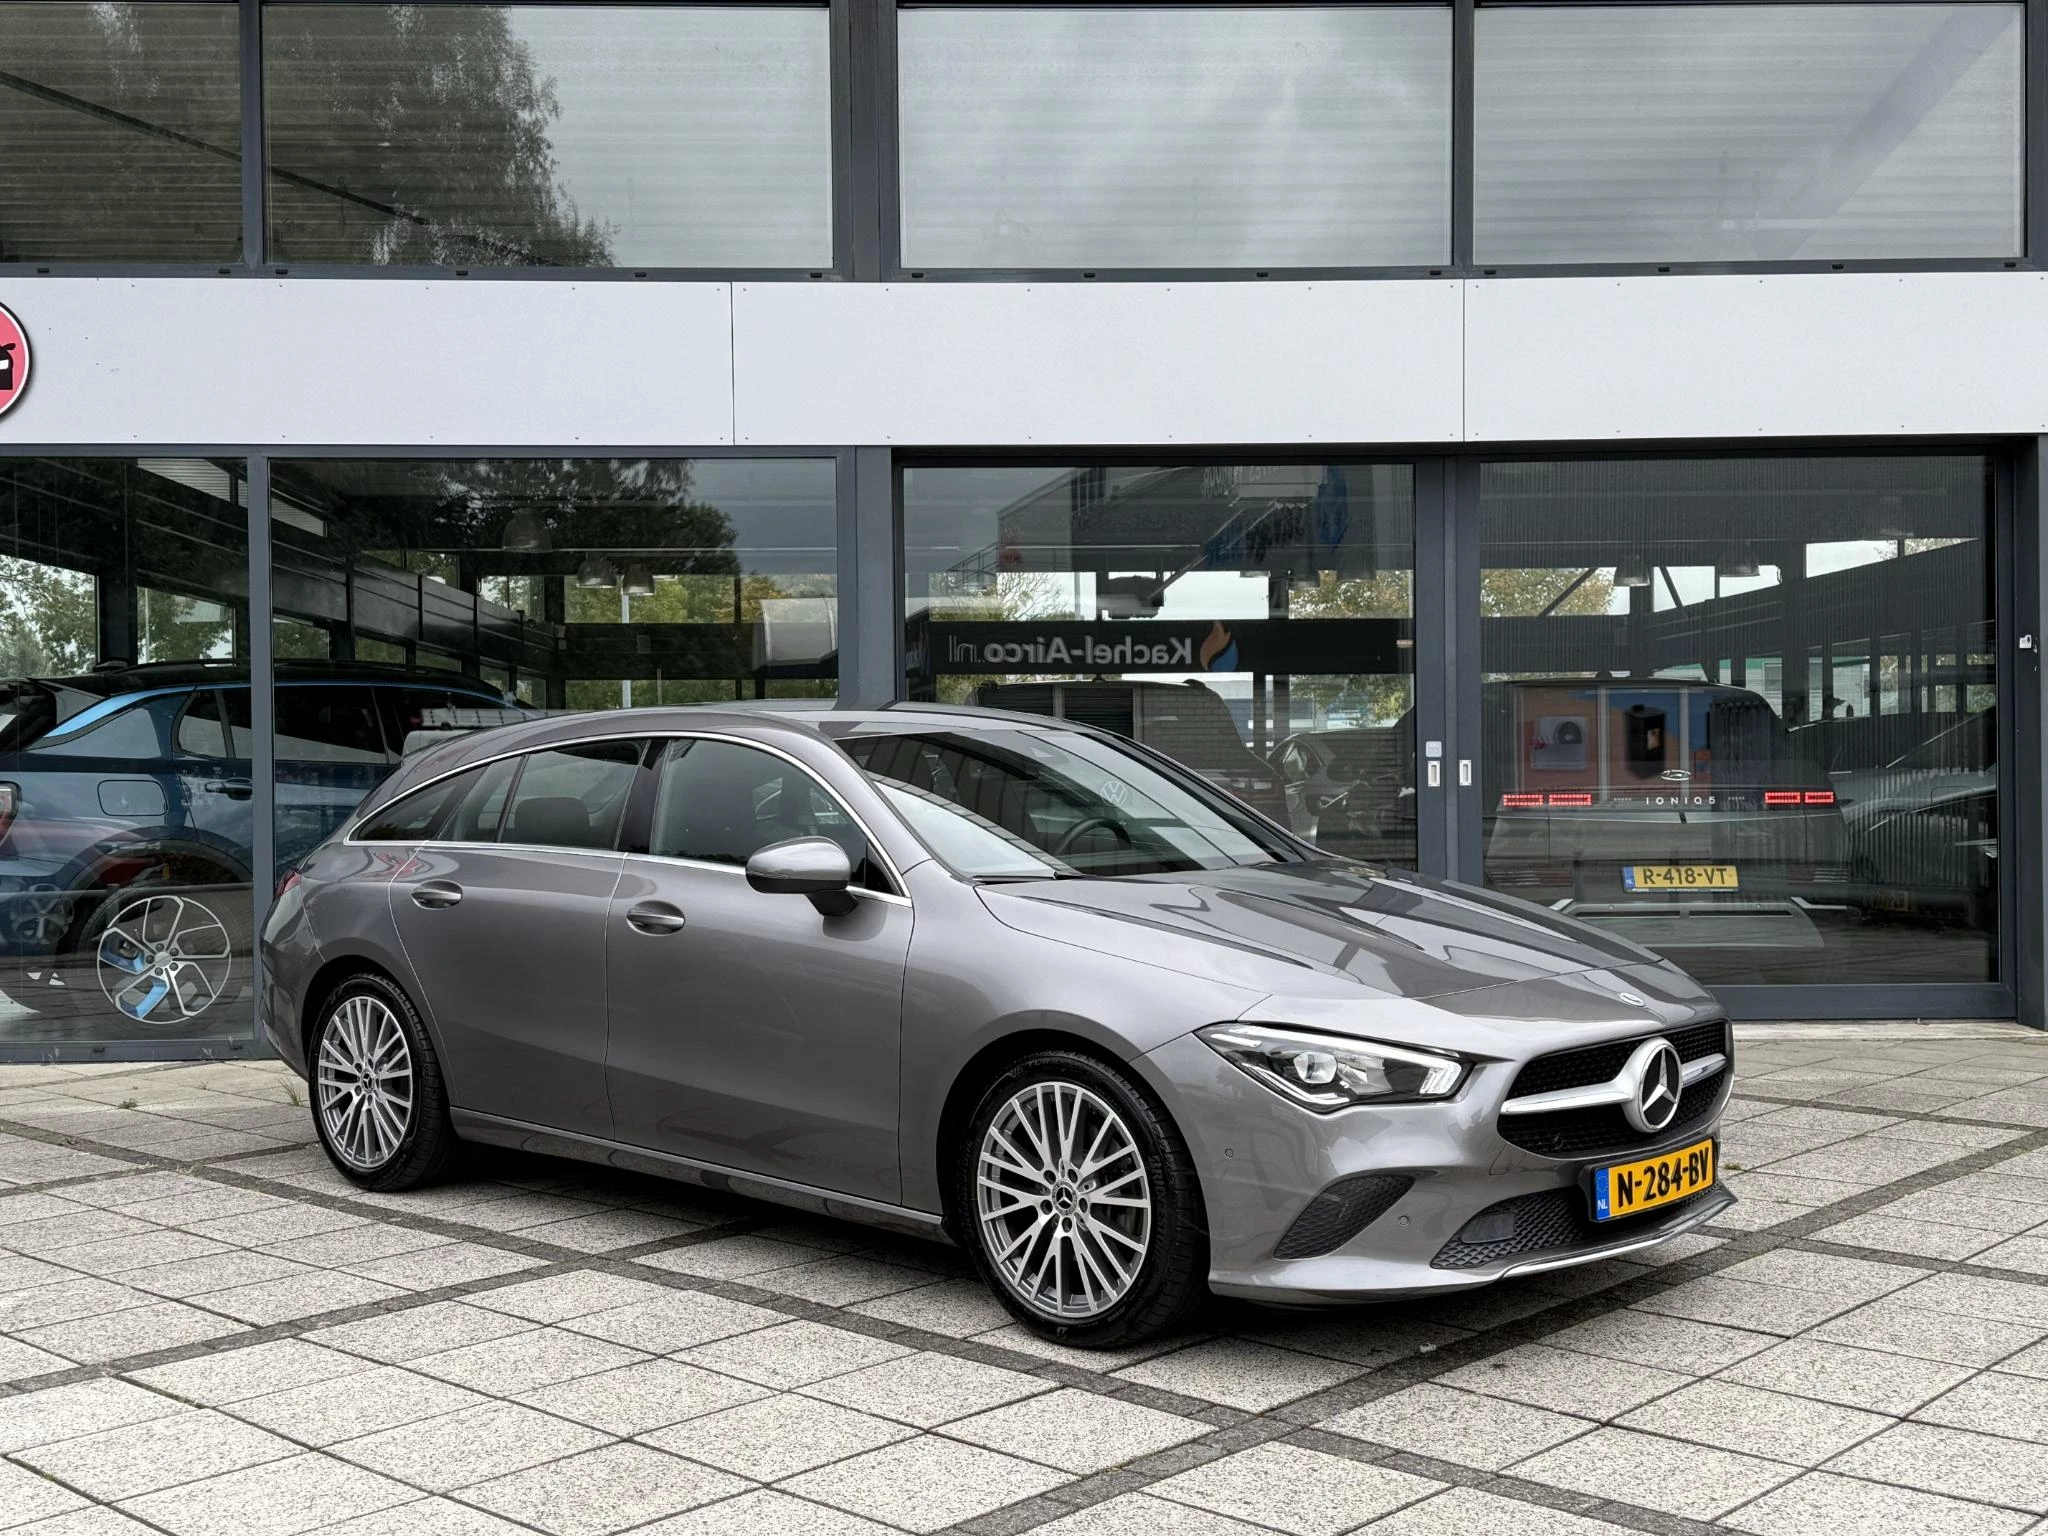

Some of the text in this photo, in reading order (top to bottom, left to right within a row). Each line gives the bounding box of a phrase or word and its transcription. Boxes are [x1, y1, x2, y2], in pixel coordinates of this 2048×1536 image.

[1642, 867, 1727, 885] R-418-VT
[1617, 1147, 1709, 1208] N-284-BV
[1597, 1199, 1609, 1210] NL
